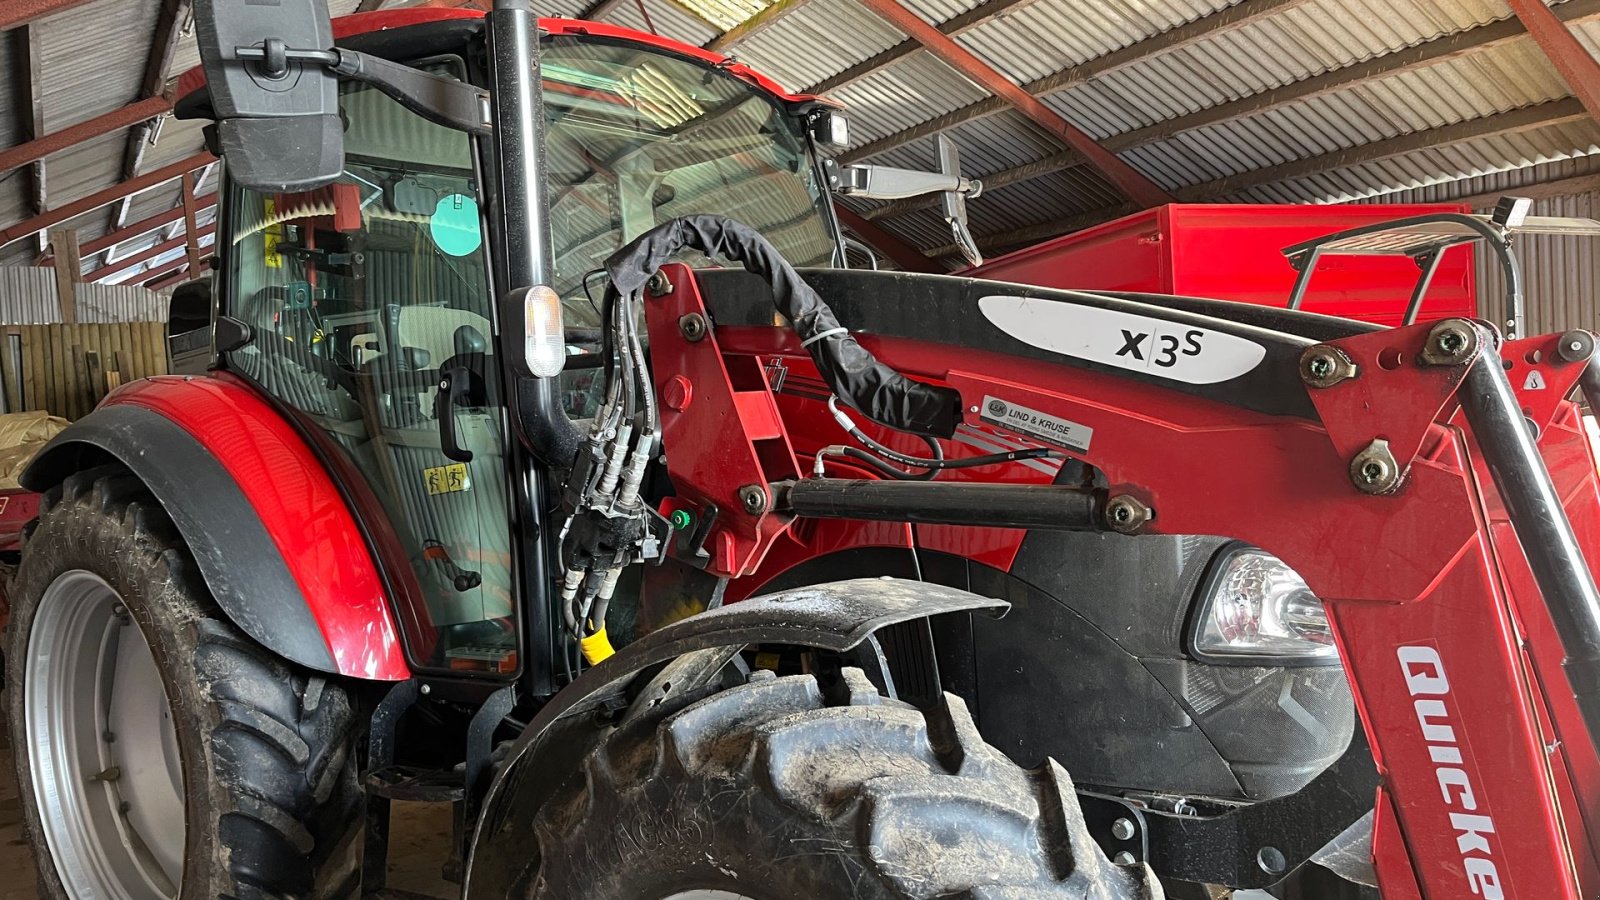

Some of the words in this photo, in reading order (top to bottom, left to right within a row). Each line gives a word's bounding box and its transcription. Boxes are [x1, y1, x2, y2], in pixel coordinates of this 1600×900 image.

[989, 402, 1004, 414] L&K
[1009, 409, 1029, 422] LIND
[1030, 416, 1037, 425] &
[1038, 418, 1070, 434] KRUSE
[1397, 646, 1504, 900] Quicke
